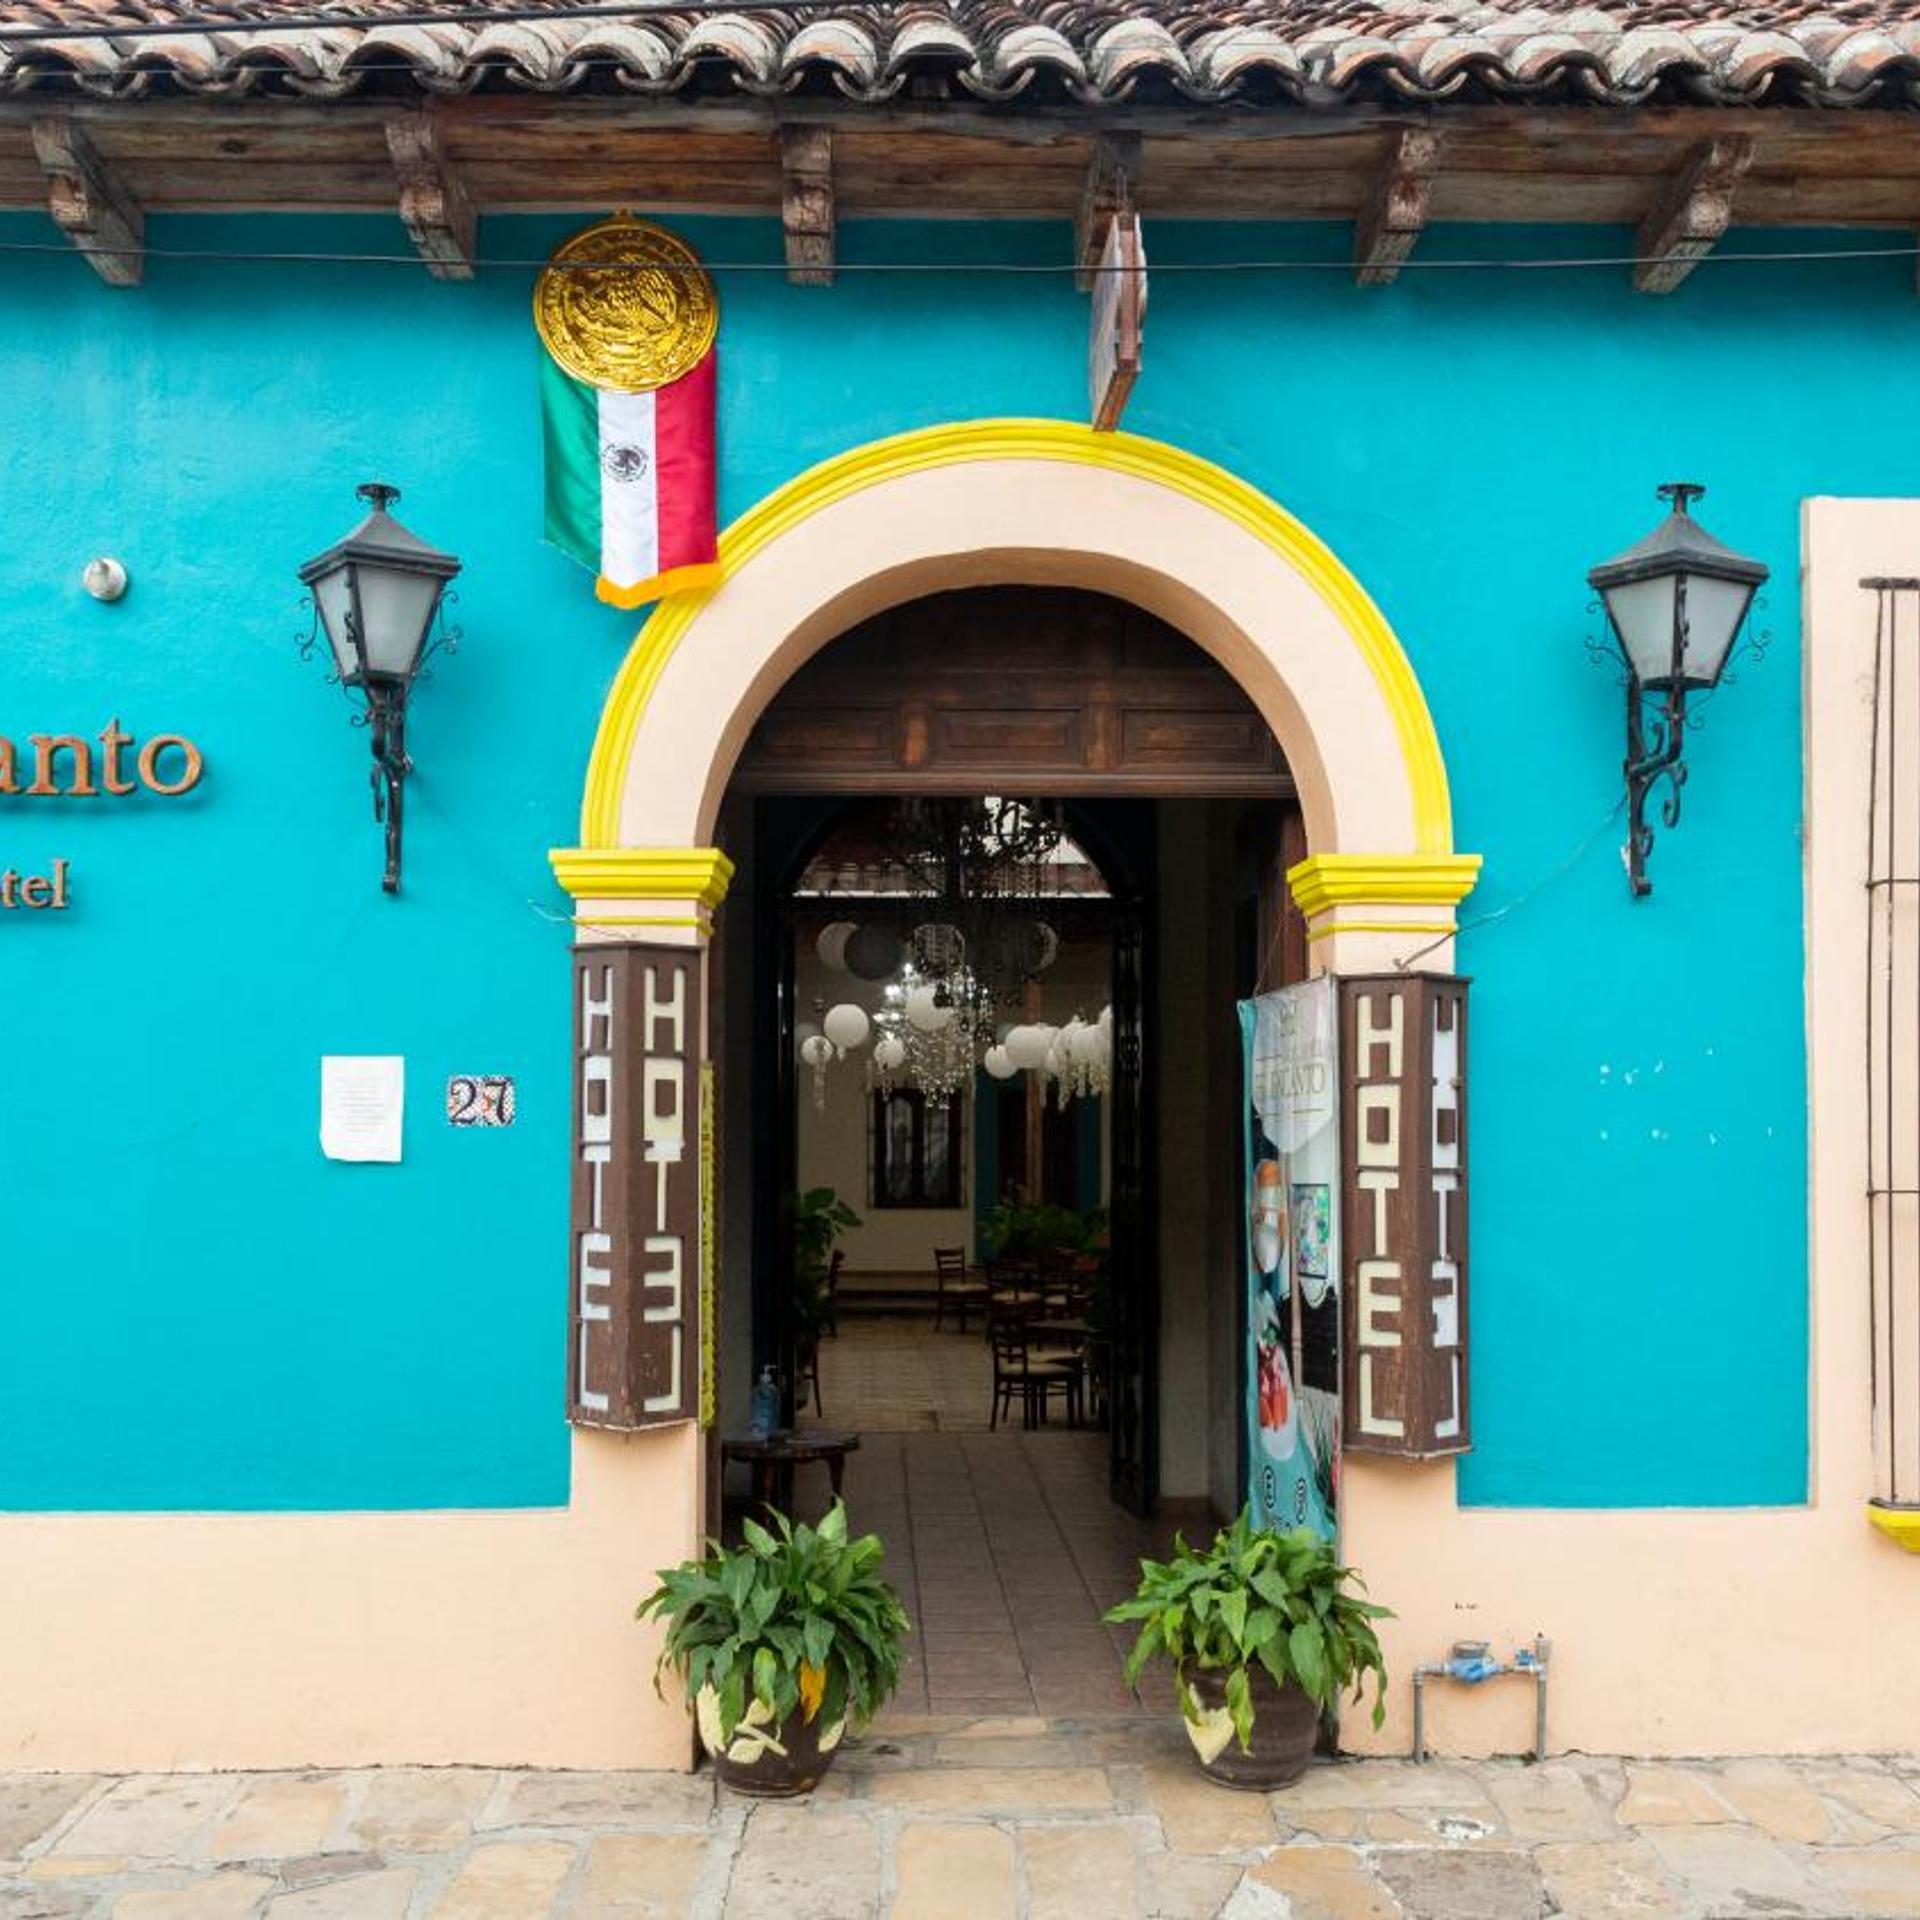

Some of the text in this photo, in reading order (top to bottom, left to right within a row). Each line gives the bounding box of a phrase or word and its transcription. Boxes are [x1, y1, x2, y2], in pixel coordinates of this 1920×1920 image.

[0, 858, 69, 910] tel
[449, 1078, 508, 1124] 27
[579, 967, 612, 1412] HOTEL
[1357, 994, 1404, 1437] HOTEL
